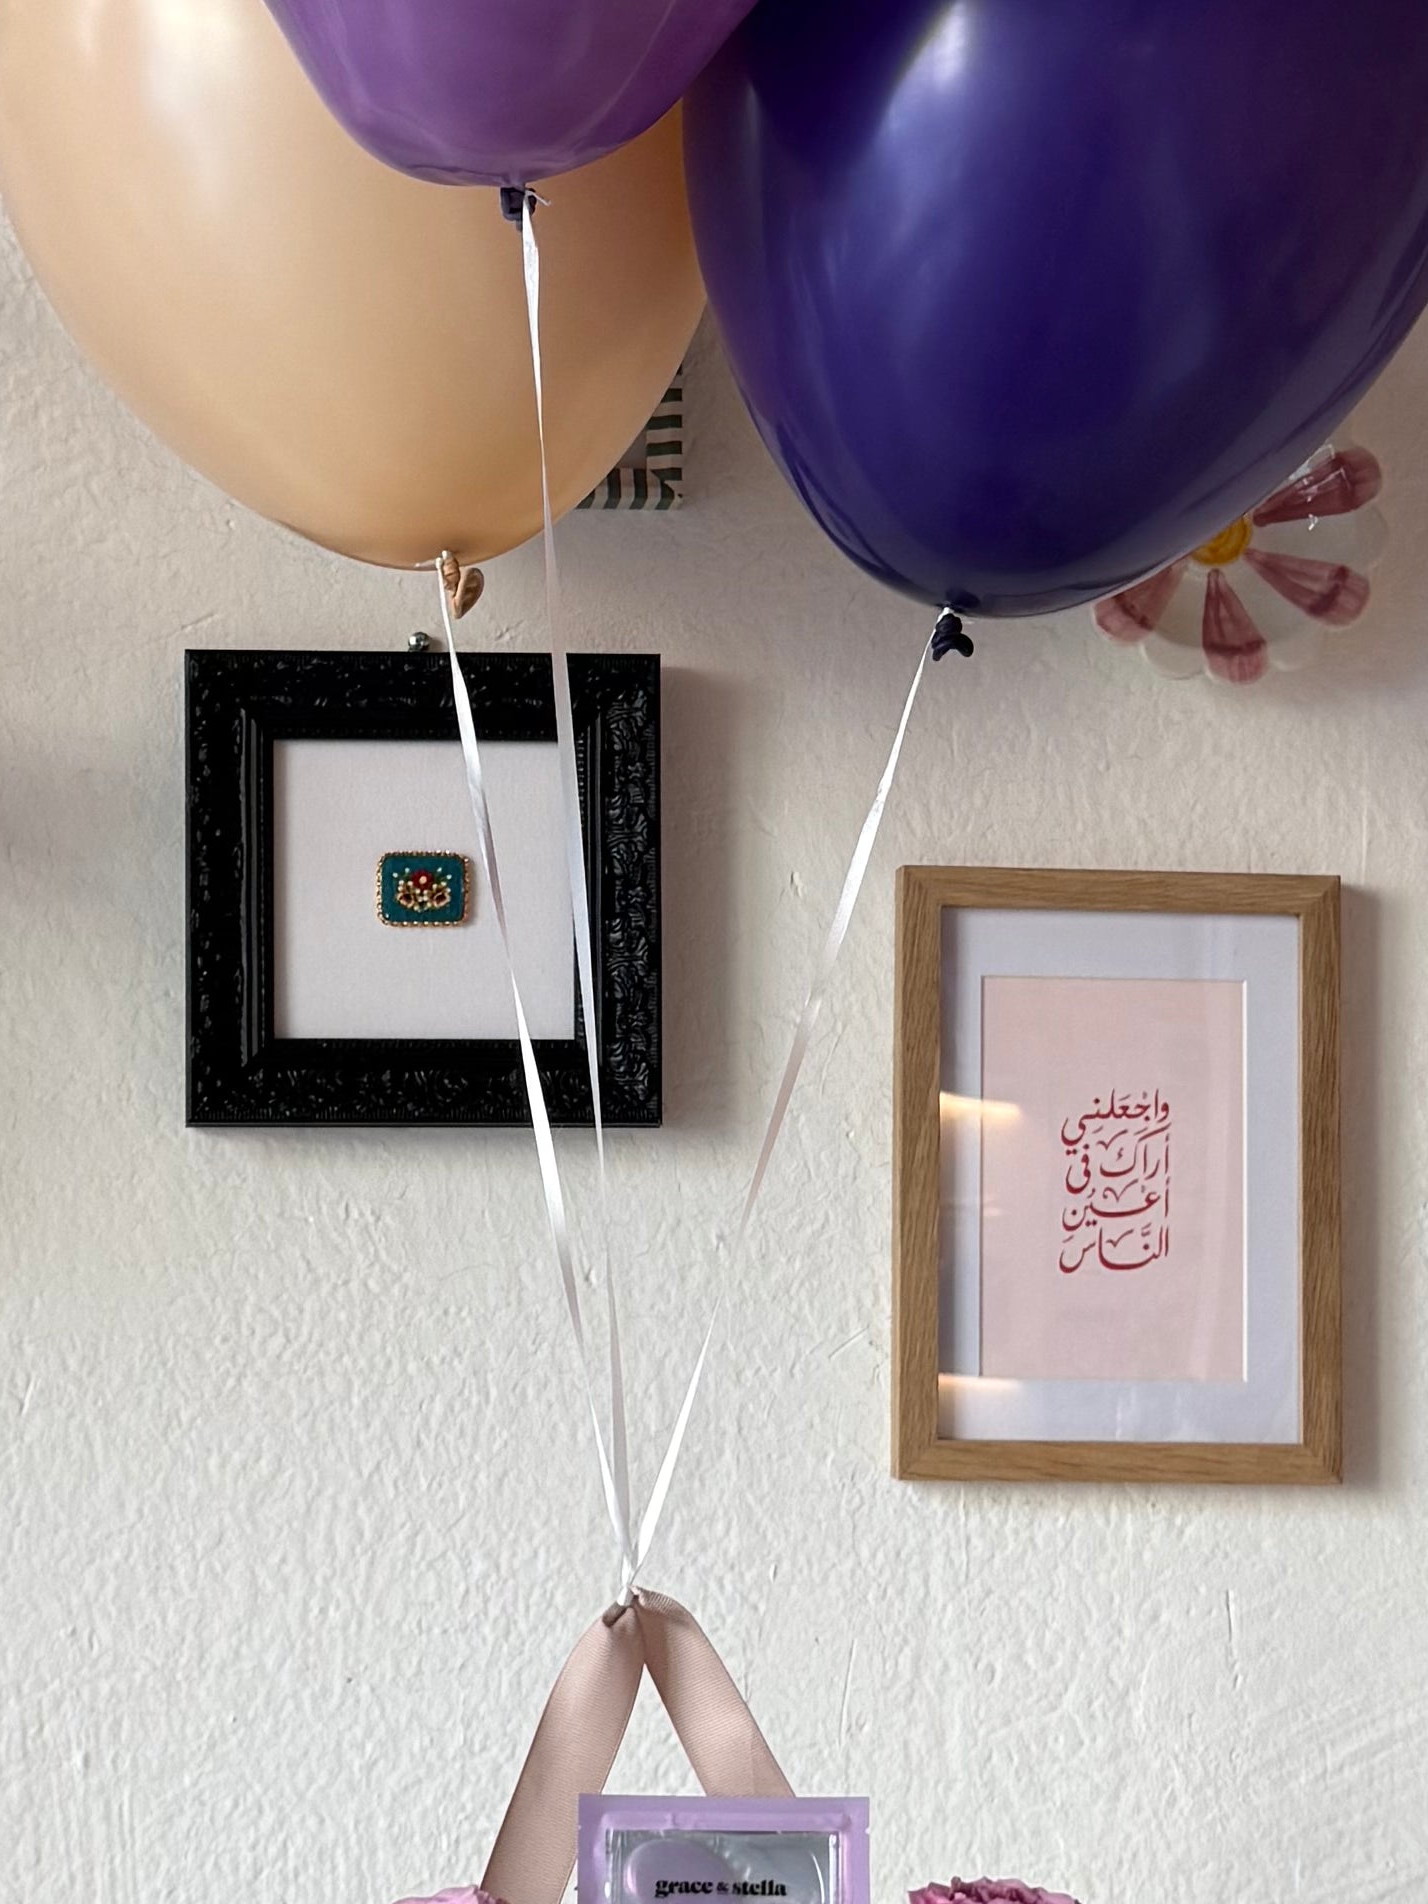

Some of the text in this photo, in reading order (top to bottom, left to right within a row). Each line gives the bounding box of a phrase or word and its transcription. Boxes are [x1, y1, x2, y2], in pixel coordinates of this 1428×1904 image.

[655, 1879, 788, 1898] grace & stella
